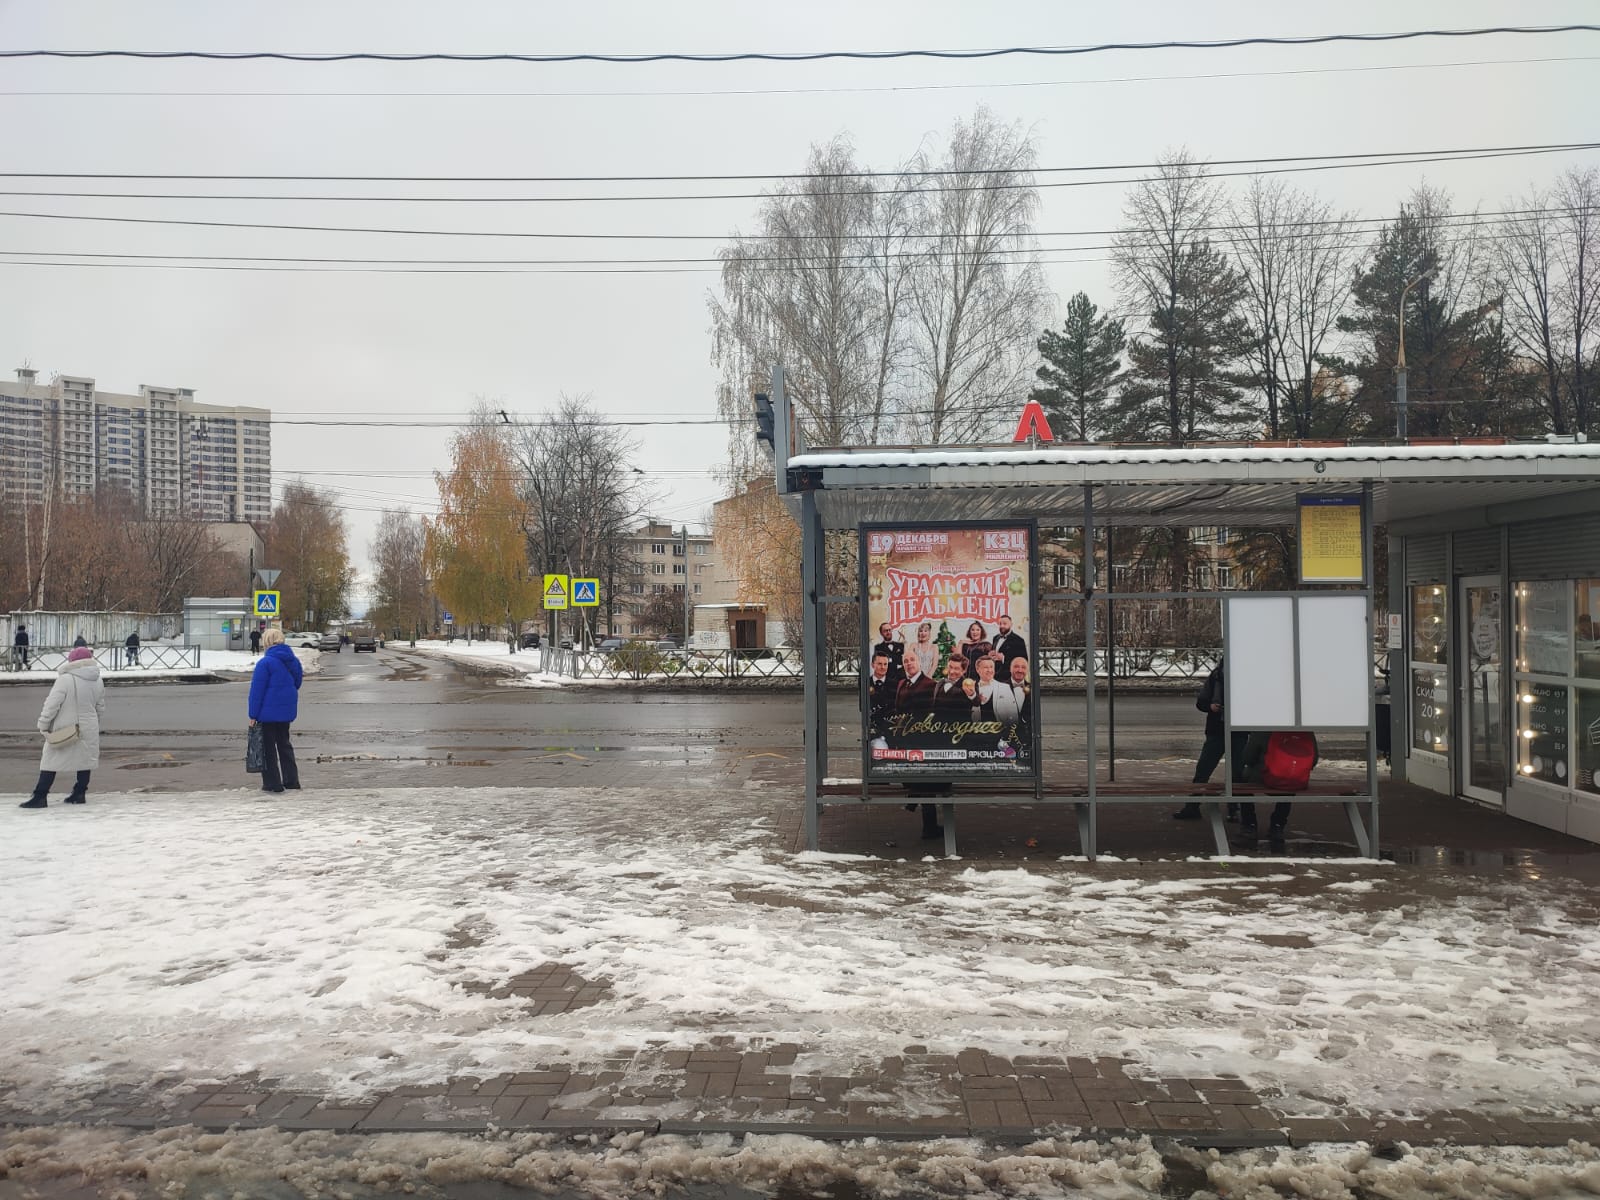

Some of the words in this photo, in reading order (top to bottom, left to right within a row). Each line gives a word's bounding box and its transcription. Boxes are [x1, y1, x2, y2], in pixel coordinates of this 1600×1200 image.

[871, 534, 893, 552] 19
[896, 534, 948, 545] ДЕКАБРЯ
[984, 532, 1026, 551] КЗЦ
[890, 570, 1008, 597] УРАЛЬСКИЕ
[891, 595, 1007, 625] ПЕЛЬМЕНИ
